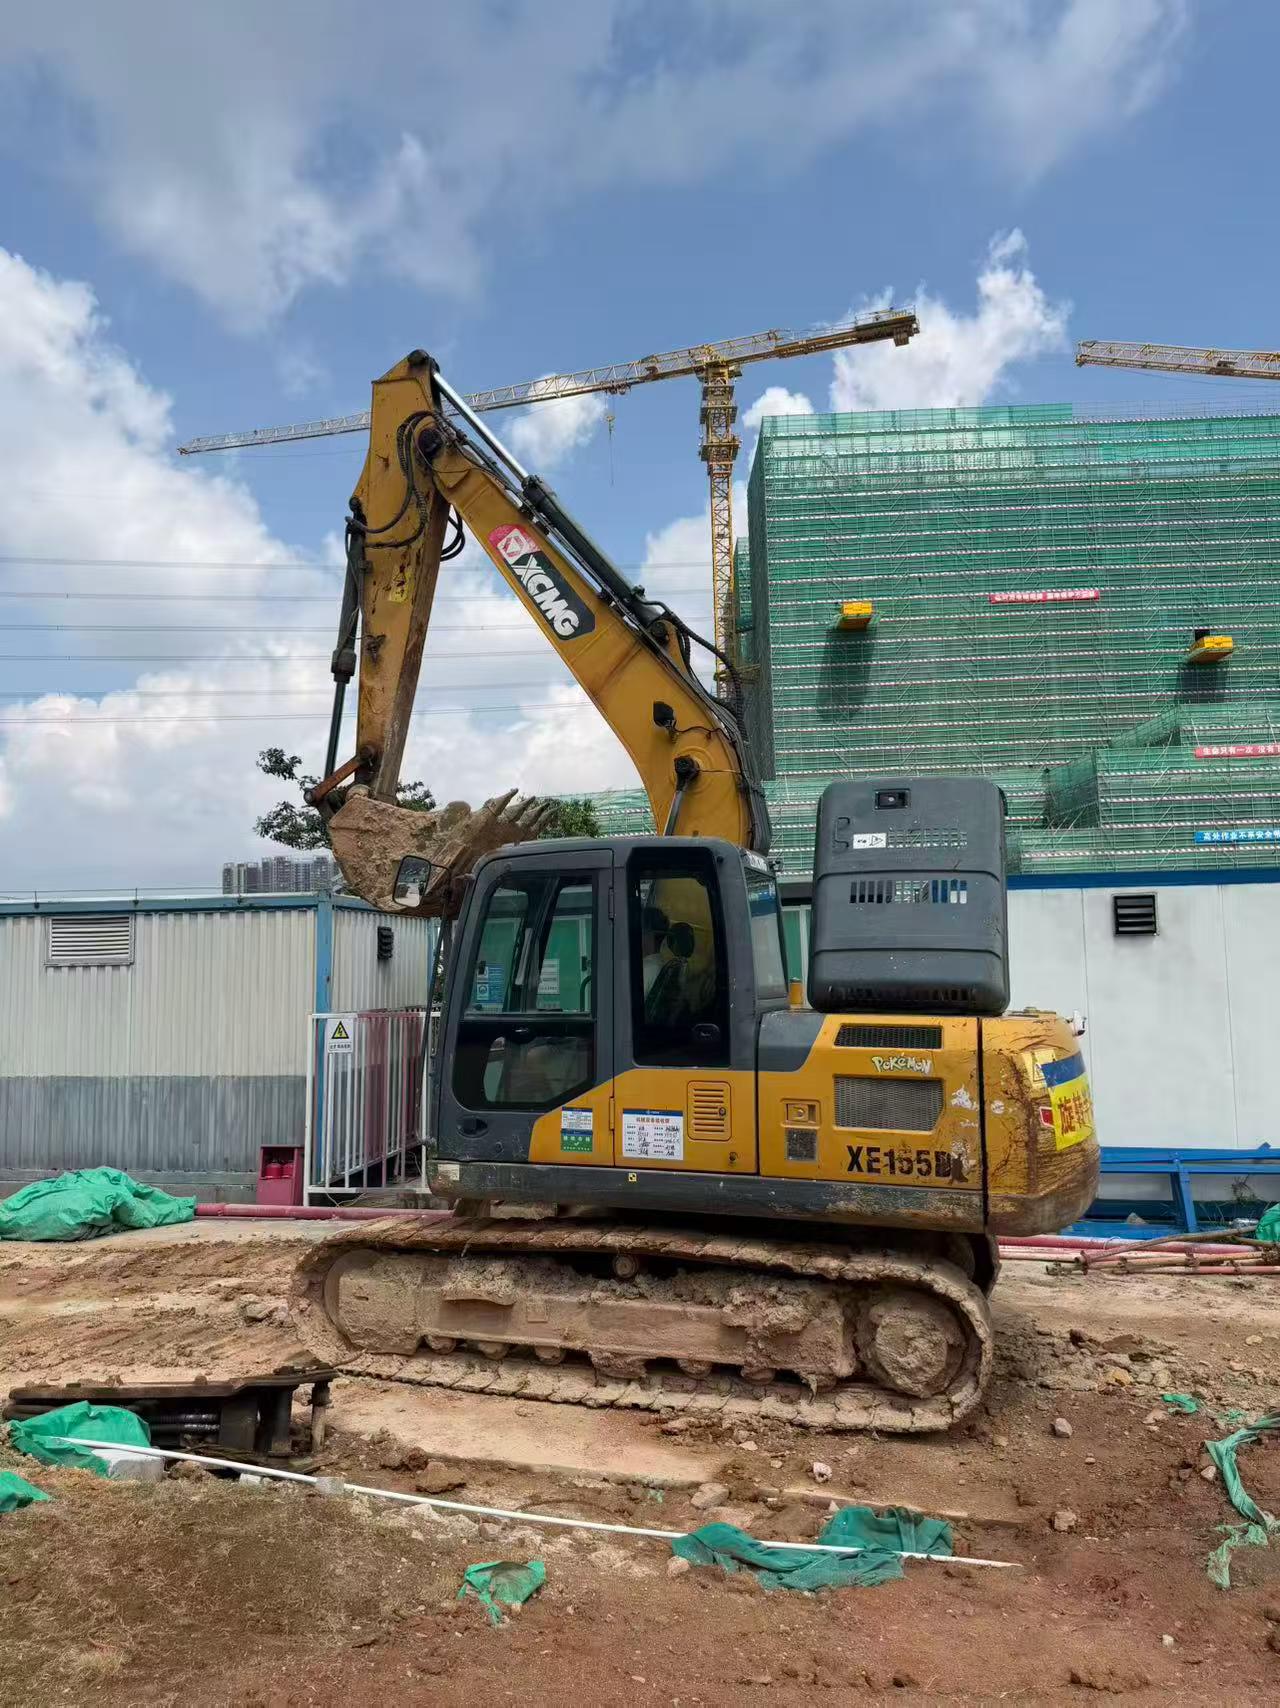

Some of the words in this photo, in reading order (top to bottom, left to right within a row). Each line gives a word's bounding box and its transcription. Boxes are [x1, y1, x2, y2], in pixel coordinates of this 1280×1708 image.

[511, 554, 580, 636] XCMG
[1203, 746, 1253, 755] 生命只有一次
